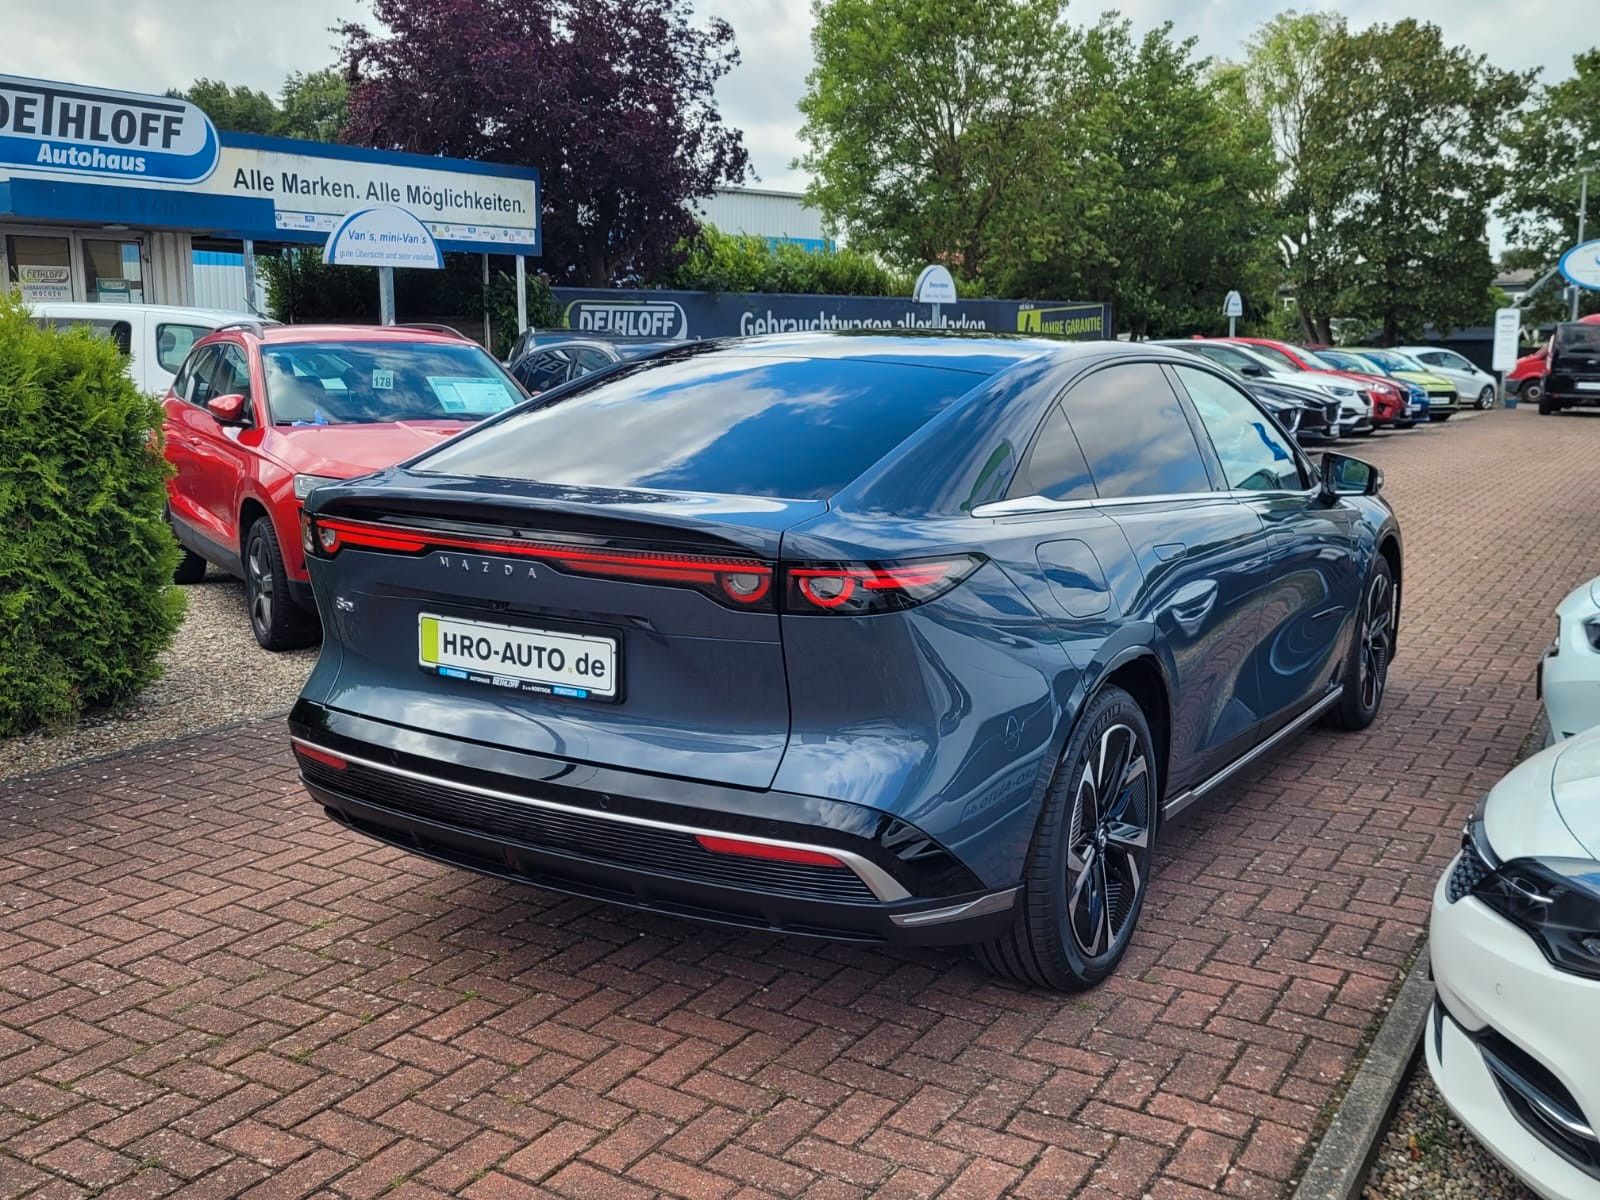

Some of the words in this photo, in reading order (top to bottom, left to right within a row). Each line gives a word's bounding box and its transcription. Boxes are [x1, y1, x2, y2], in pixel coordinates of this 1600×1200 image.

[36, 143, 146, 172] Autohaus
[233, 167, 275, 192] Alle
[281, 172, 360, 200] Marken.
[366, 181, 401, 203] Alle
[406, 184, 526, 214] Möglichkeiten.
[339, 250, 354, 258] gute
[386, 251, 397, 259] und
[578, 305, 676, 337] DETHLOFF
[1065, 316, 1101, 335] GARANTIE
[374, 377, 391, 388] 178
[439, 556, 537, 579] MAZDA
